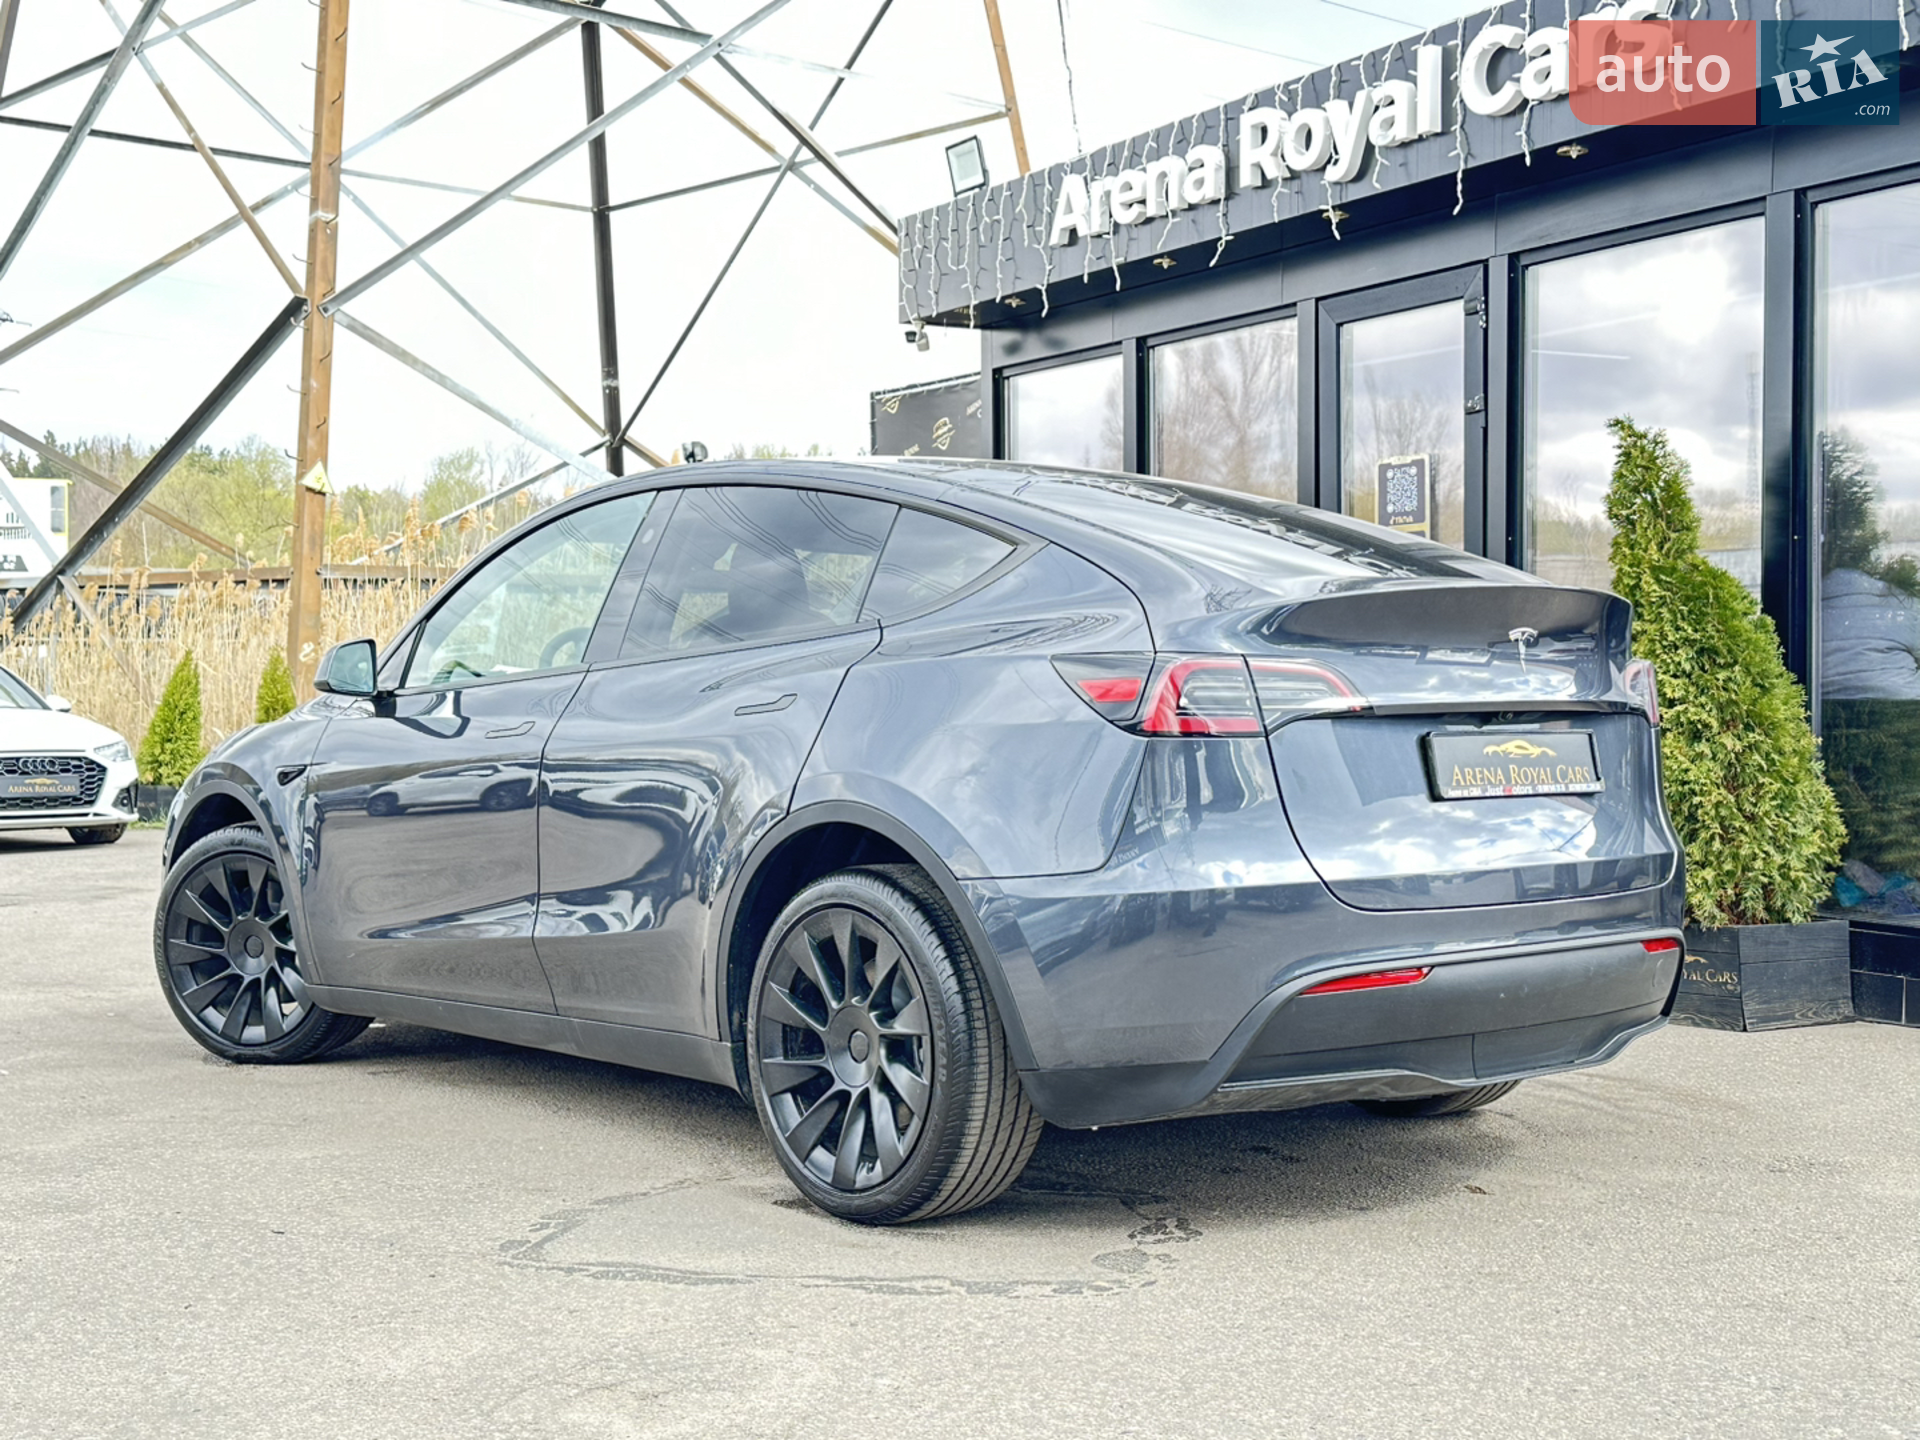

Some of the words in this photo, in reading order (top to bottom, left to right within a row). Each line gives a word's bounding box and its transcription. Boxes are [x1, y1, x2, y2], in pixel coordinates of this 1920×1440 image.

[1048, 144, 1227, 246] Arena
[1239, 44, 1442, 188] Royal
[1460, 0, 1671, 116] Cars
[1452, 764, 1506, 786] ARENA
[1509, 764, 1555, 785] ROYAL
[1556, 764, 1592, 784] CARS
[8, 785, 33, 793] ARENA
[35, 785, 57, 793] ROYAL
[57, 784, 76, 793] CARS
[1705, 968, 1738, 984] CARS
